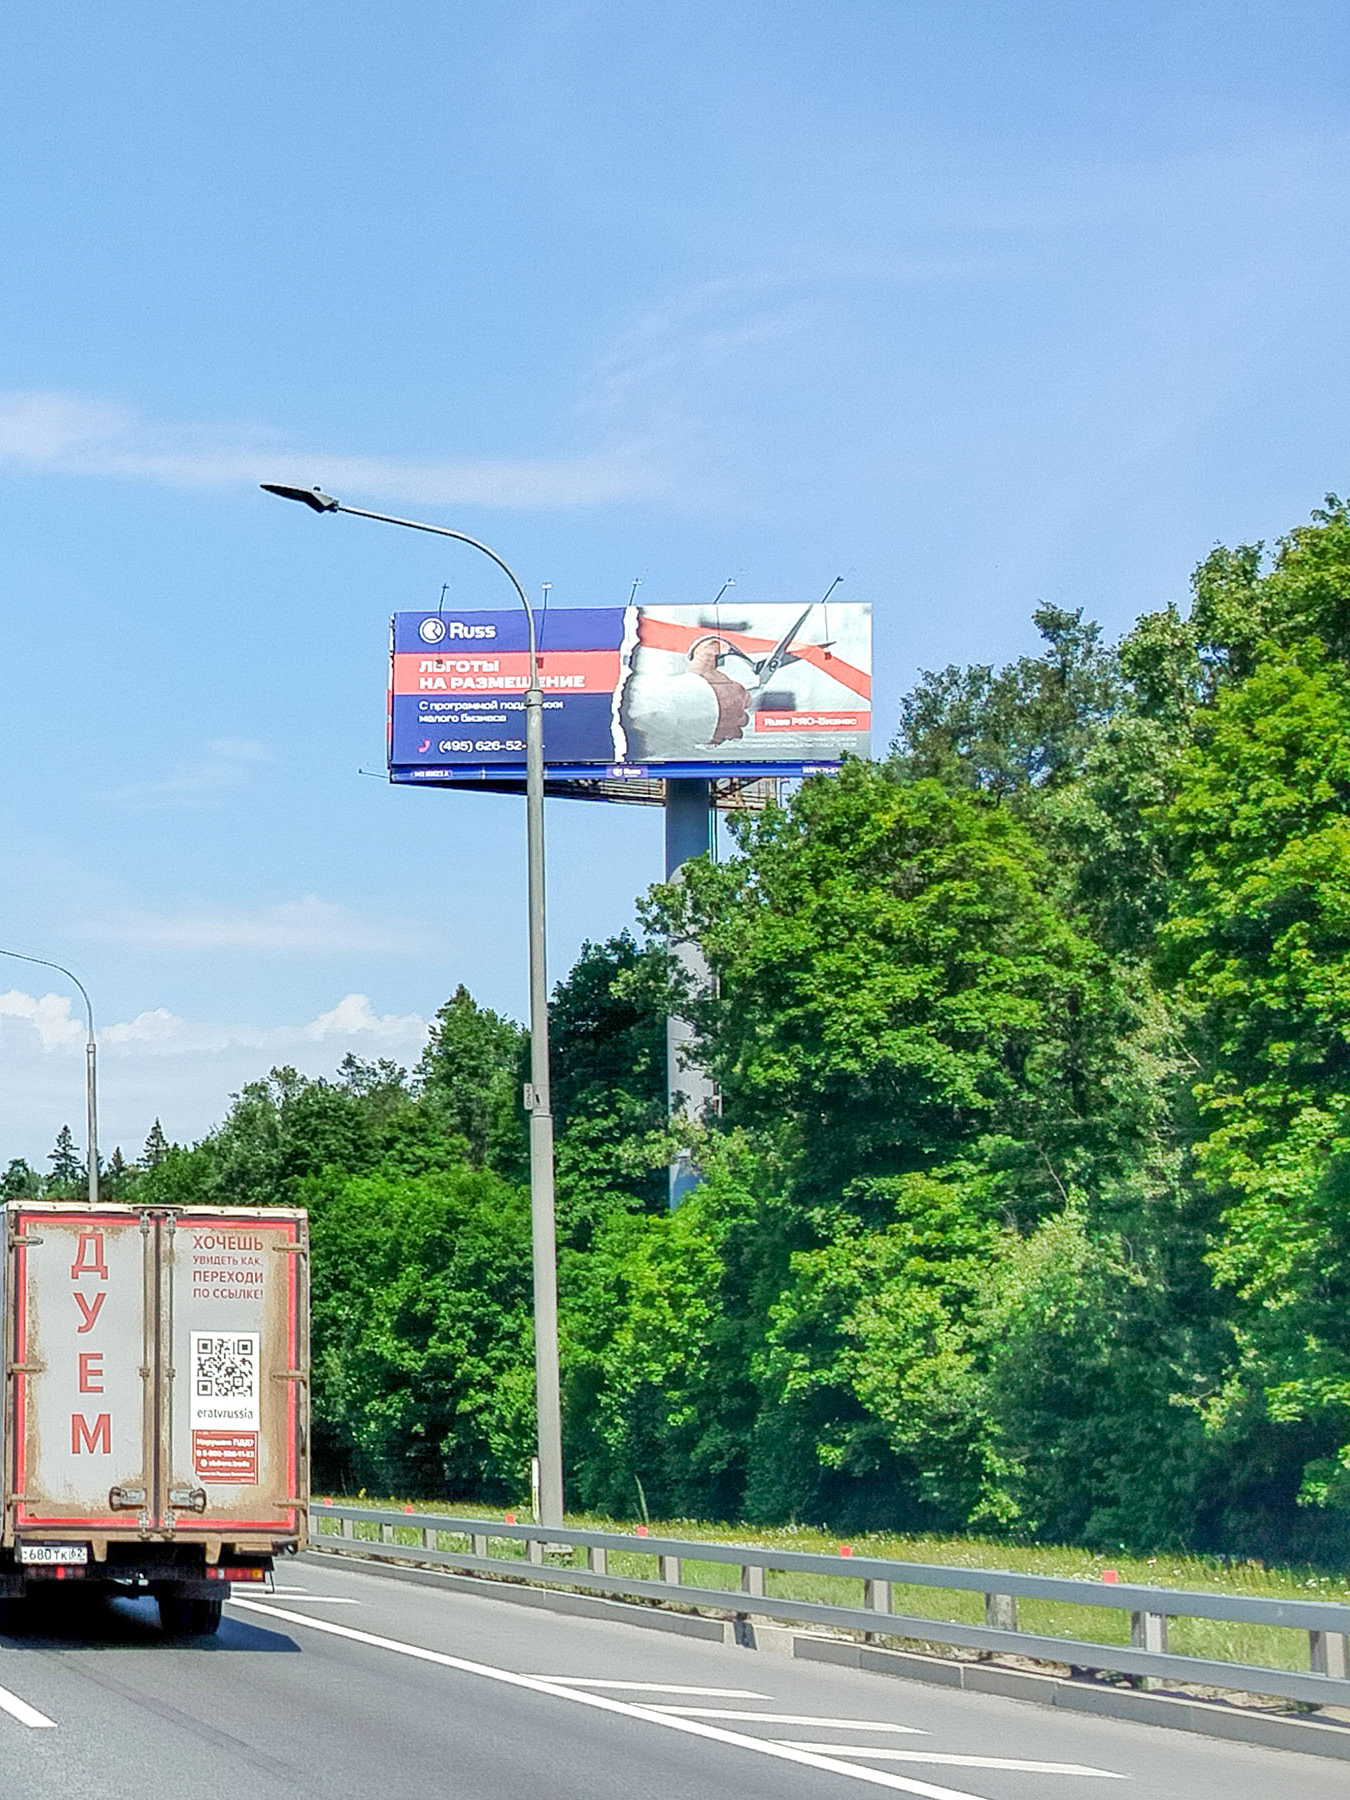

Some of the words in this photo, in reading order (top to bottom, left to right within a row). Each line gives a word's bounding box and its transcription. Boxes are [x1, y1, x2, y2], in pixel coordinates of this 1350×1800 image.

[451, 622, 496, 639] Russ
[419, 660, 499, 673] ЛЬГОТЫ
[419, 677, 447, 689] НА
[419, 700, 429, 711] С
[430, 700, 498, 712] программой
[419, 715, 460, 723] малого
[438, 740, 474, 753] (495)
[193, 1235, 264, 1251] ХОЧЕШЬ
[193, 1255, 238, 1265] УВИДЕТЬ
[193, 1271, 264, 1284] ПЕРЕХОДИ
[193, 1288, 210, 1299] ПО
[212, 1288, 264, 1300] ССЫЛКЕ!
[71, 1233, 111, 1454] ДУЕМ
[197, 1408, 254, 1419] eratvrussia
